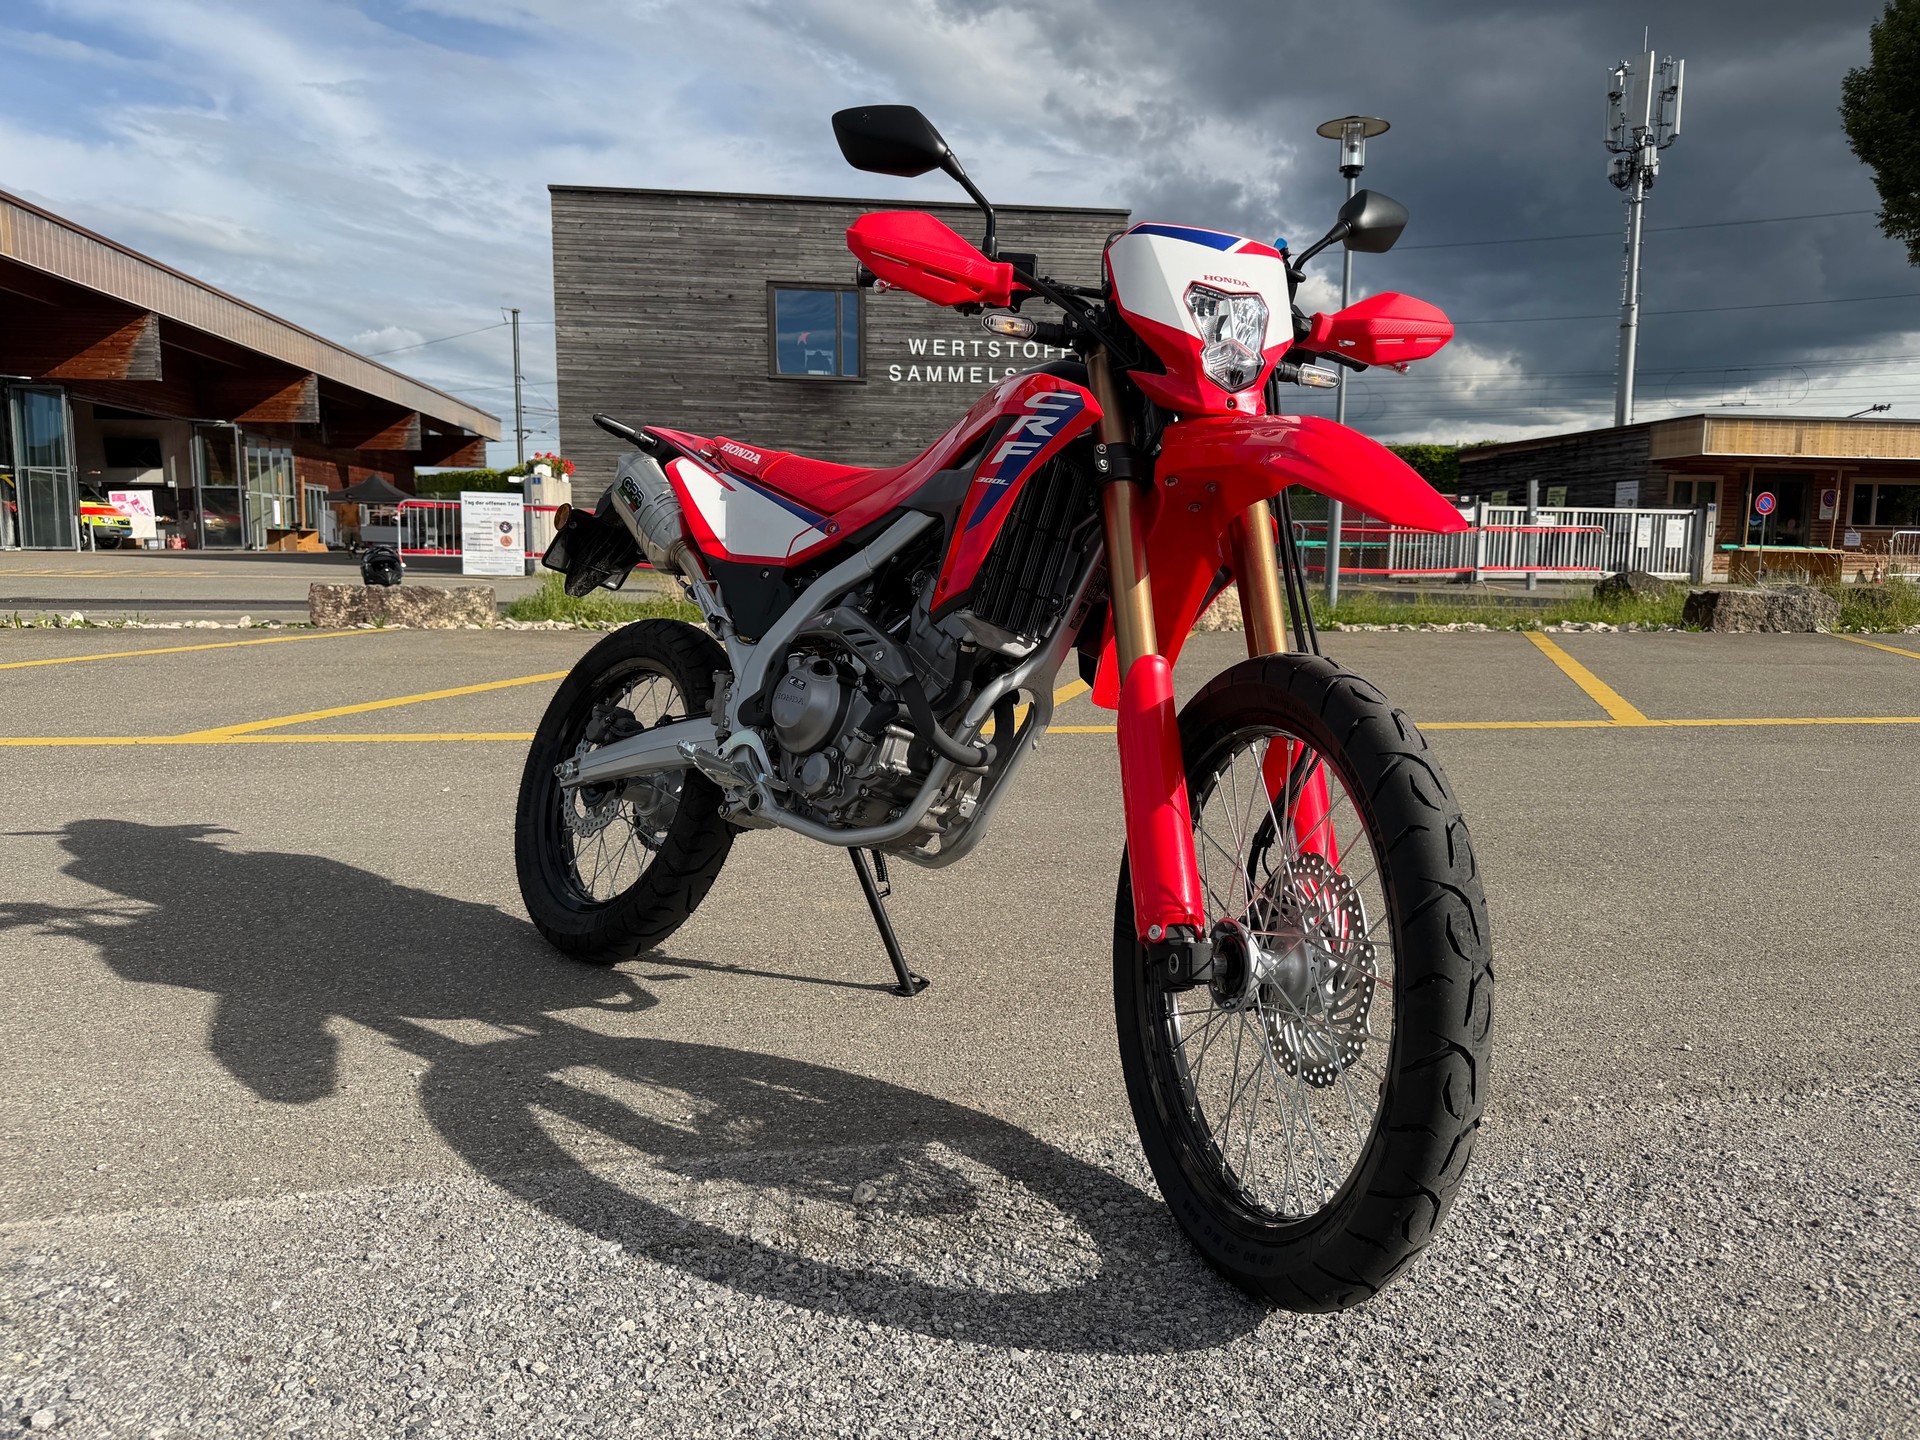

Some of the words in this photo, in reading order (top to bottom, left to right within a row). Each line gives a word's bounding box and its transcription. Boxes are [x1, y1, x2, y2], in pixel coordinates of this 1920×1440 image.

[1203, 274, 1250, 288] HONDA
[990, 391, 1082, 465] CRF
[720, 442, 762, 465] HONDA
[975, 476, 1010, 486] 300L
[775, 692, 804, 706] HONDA
